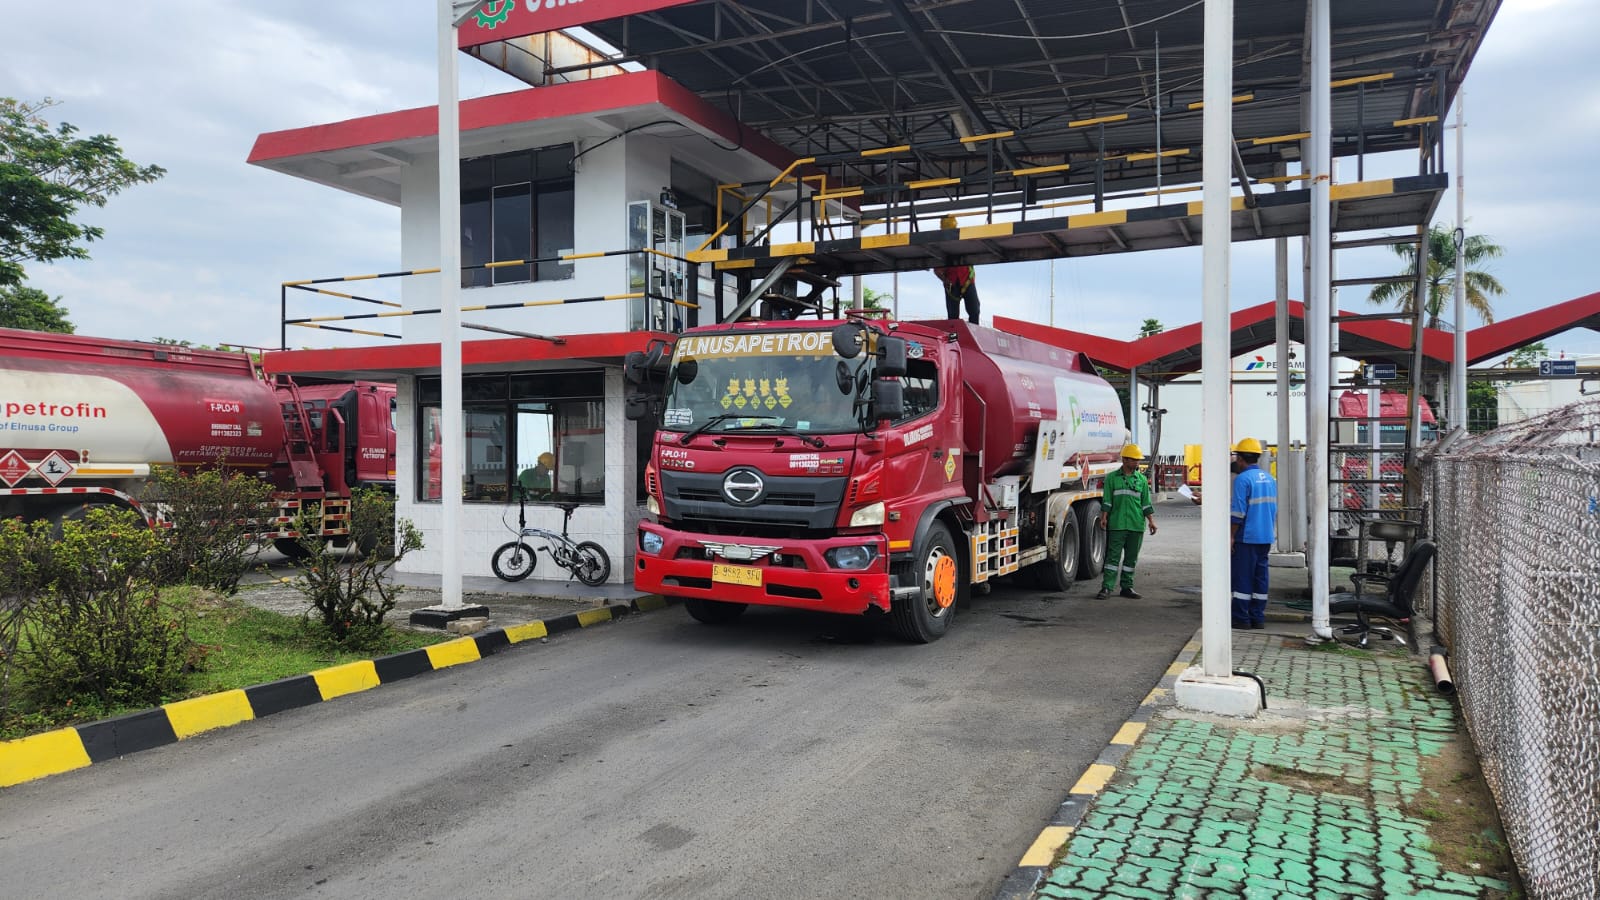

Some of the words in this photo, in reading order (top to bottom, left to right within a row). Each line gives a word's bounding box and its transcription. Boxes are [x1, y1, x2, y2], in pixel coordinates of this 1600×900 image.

[678, 332, 832, 356] ELNUSAPETROF
[1266, 361, 1305, 369] PEAMI
[1542, 361, 1551, 374] 3
[0, 402, 107, 418] petrofin
[11, 422, 46, 432] Elnusa
[48, 423, 79, 434] Group
[662, 458, 696, 469] HINO
